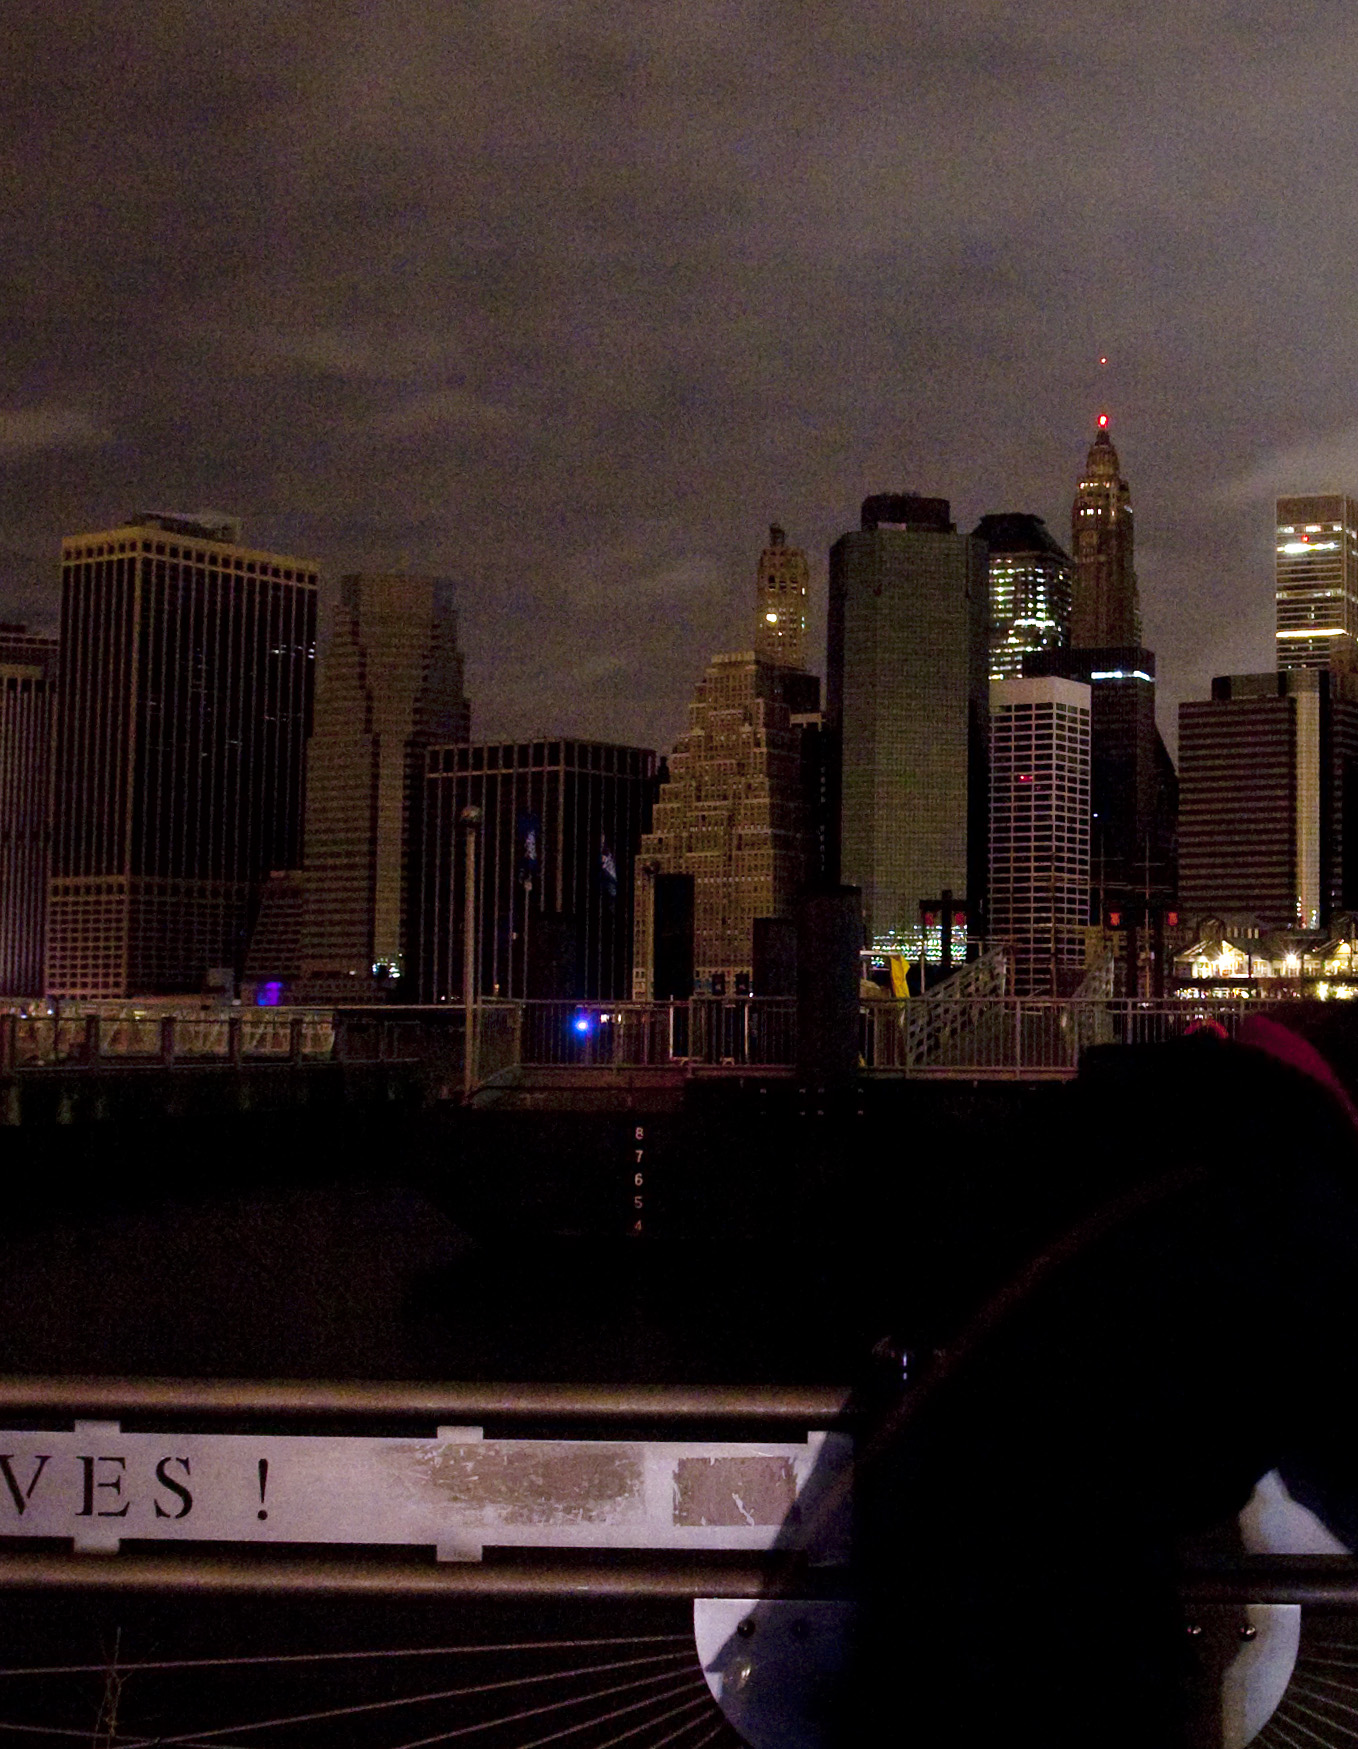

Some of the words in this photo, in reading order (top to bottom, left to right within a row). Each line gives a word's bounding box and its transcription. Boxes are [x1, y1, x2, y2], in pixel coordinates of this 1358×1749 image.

[634, 1126, 644, 1140] 8
[634, 1149, 644, 1163] 7
[634, 1172, 644, 1187] 6
[634, 1195, 643, 1209] 5
